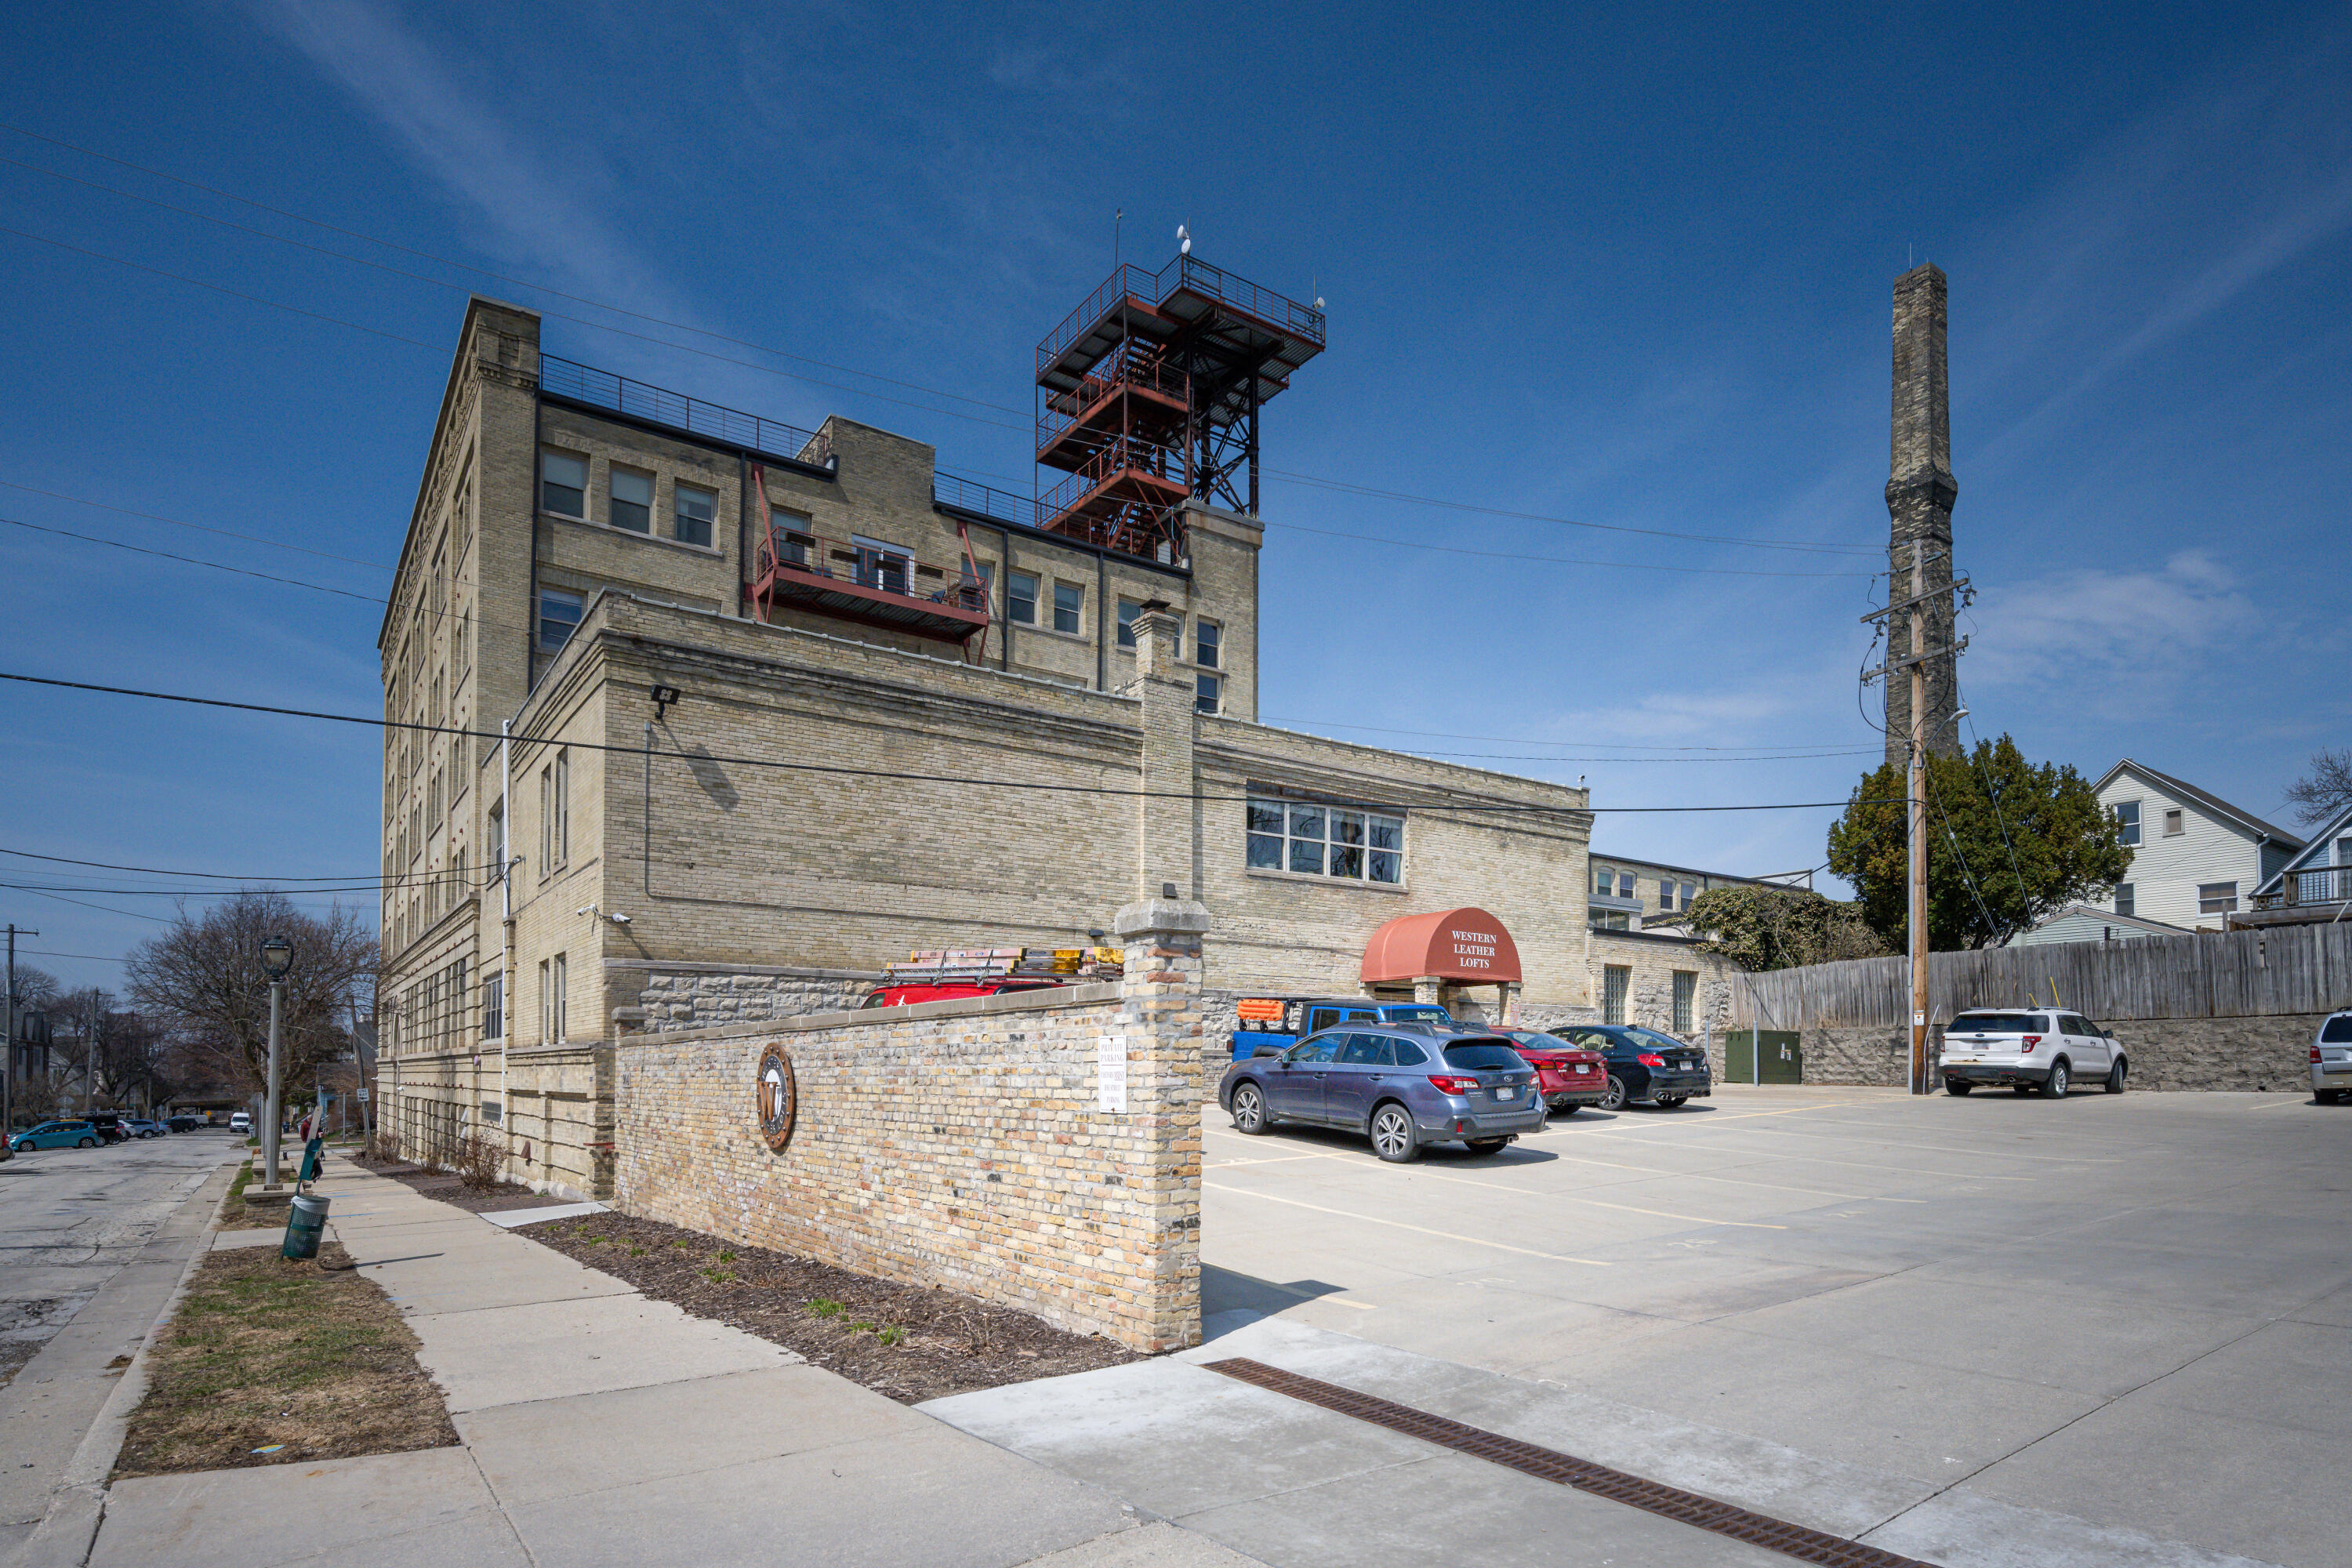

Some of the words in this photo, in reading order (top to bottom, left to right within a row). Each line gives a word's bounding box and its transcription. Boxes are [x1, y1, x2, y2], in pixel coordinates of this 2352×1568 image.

[1452, 931, 1497, 944] WESTERN
[1454, 944, 1495, 956] LEATHER
[1460, 957, 1490, 968] LOFTS
[1102, 1044, 1123, 1052] PRIVATE
[1101, 1054, 1124, 1062] PARKING
[1114, 1070, 1124, 1080] MUST
